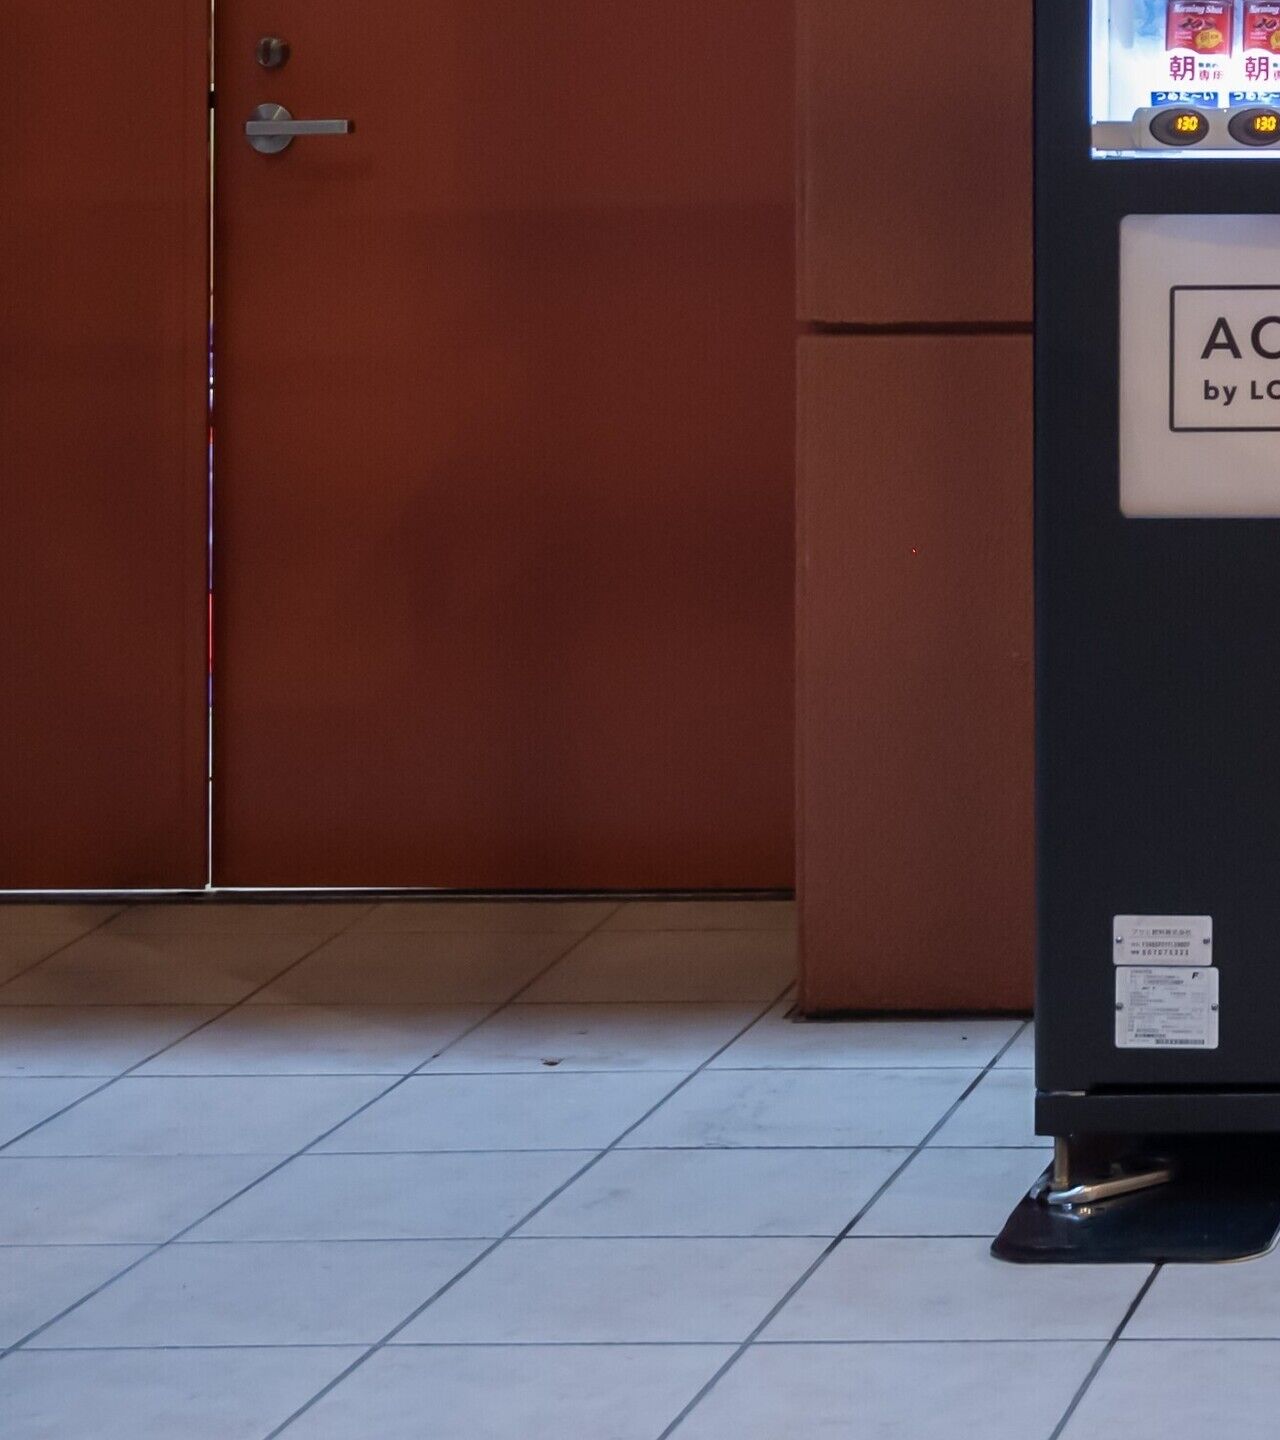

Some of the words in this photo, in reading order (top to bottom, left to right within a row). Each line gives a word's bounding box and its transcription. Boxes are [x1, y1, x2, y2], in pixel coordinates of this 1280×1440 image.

[1169, 55, 1195, 81] 朝
[1245, 56, 1270, 81] 朝
[1177, 116, 1199, 131] 130
[1256, 116, 1277, 131] 130
[1203, 379, 1238, 406] by
